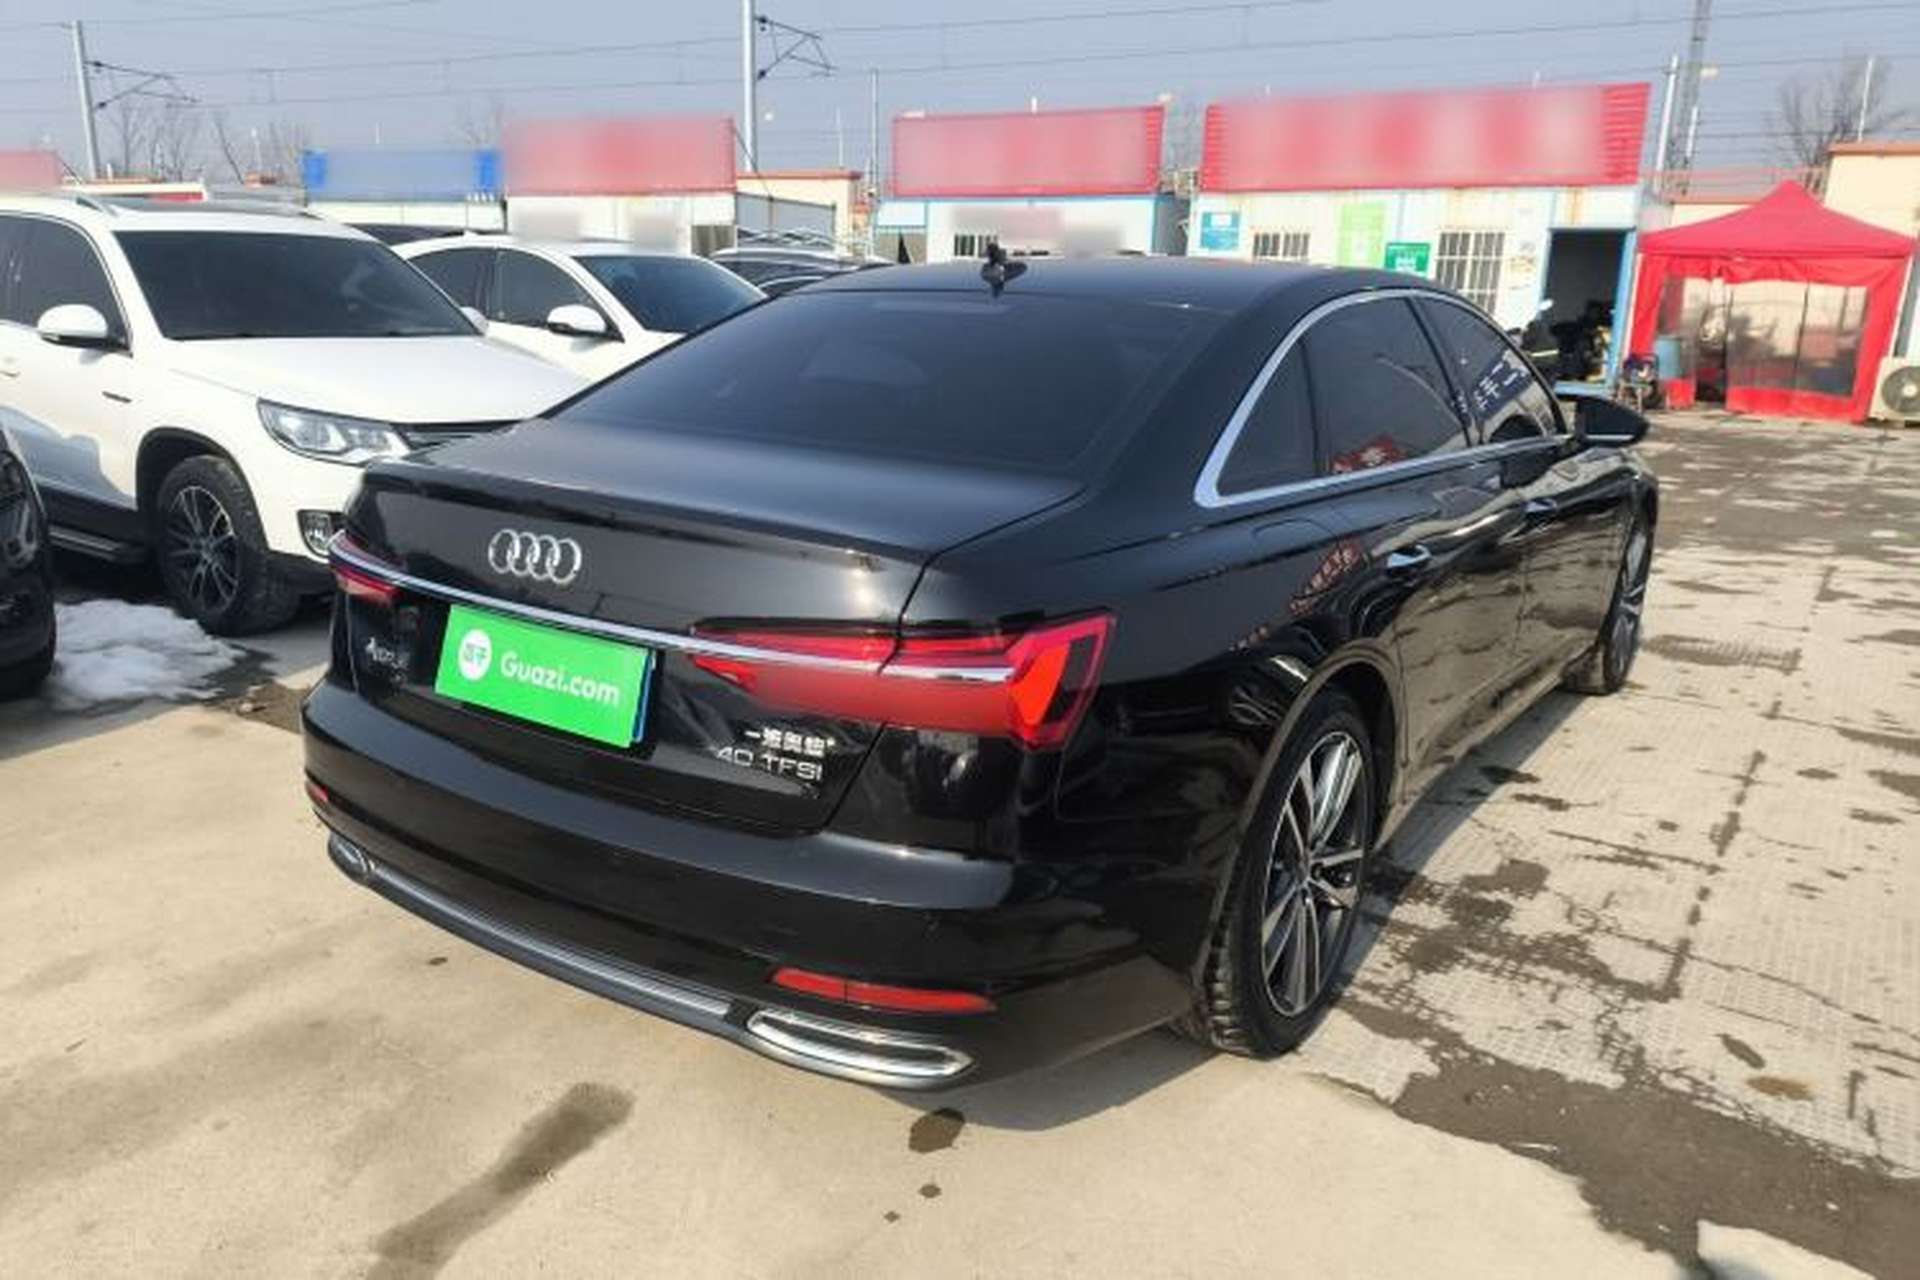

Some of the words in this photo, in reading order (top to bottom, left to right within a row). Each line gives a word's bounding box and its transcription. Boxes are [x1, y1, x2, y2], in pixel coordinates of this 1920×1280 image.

[501, 651, 621, 705] Guazi.com
[717, 746, 754, 767] 40
[761, 753, 823, 781] TFSI
